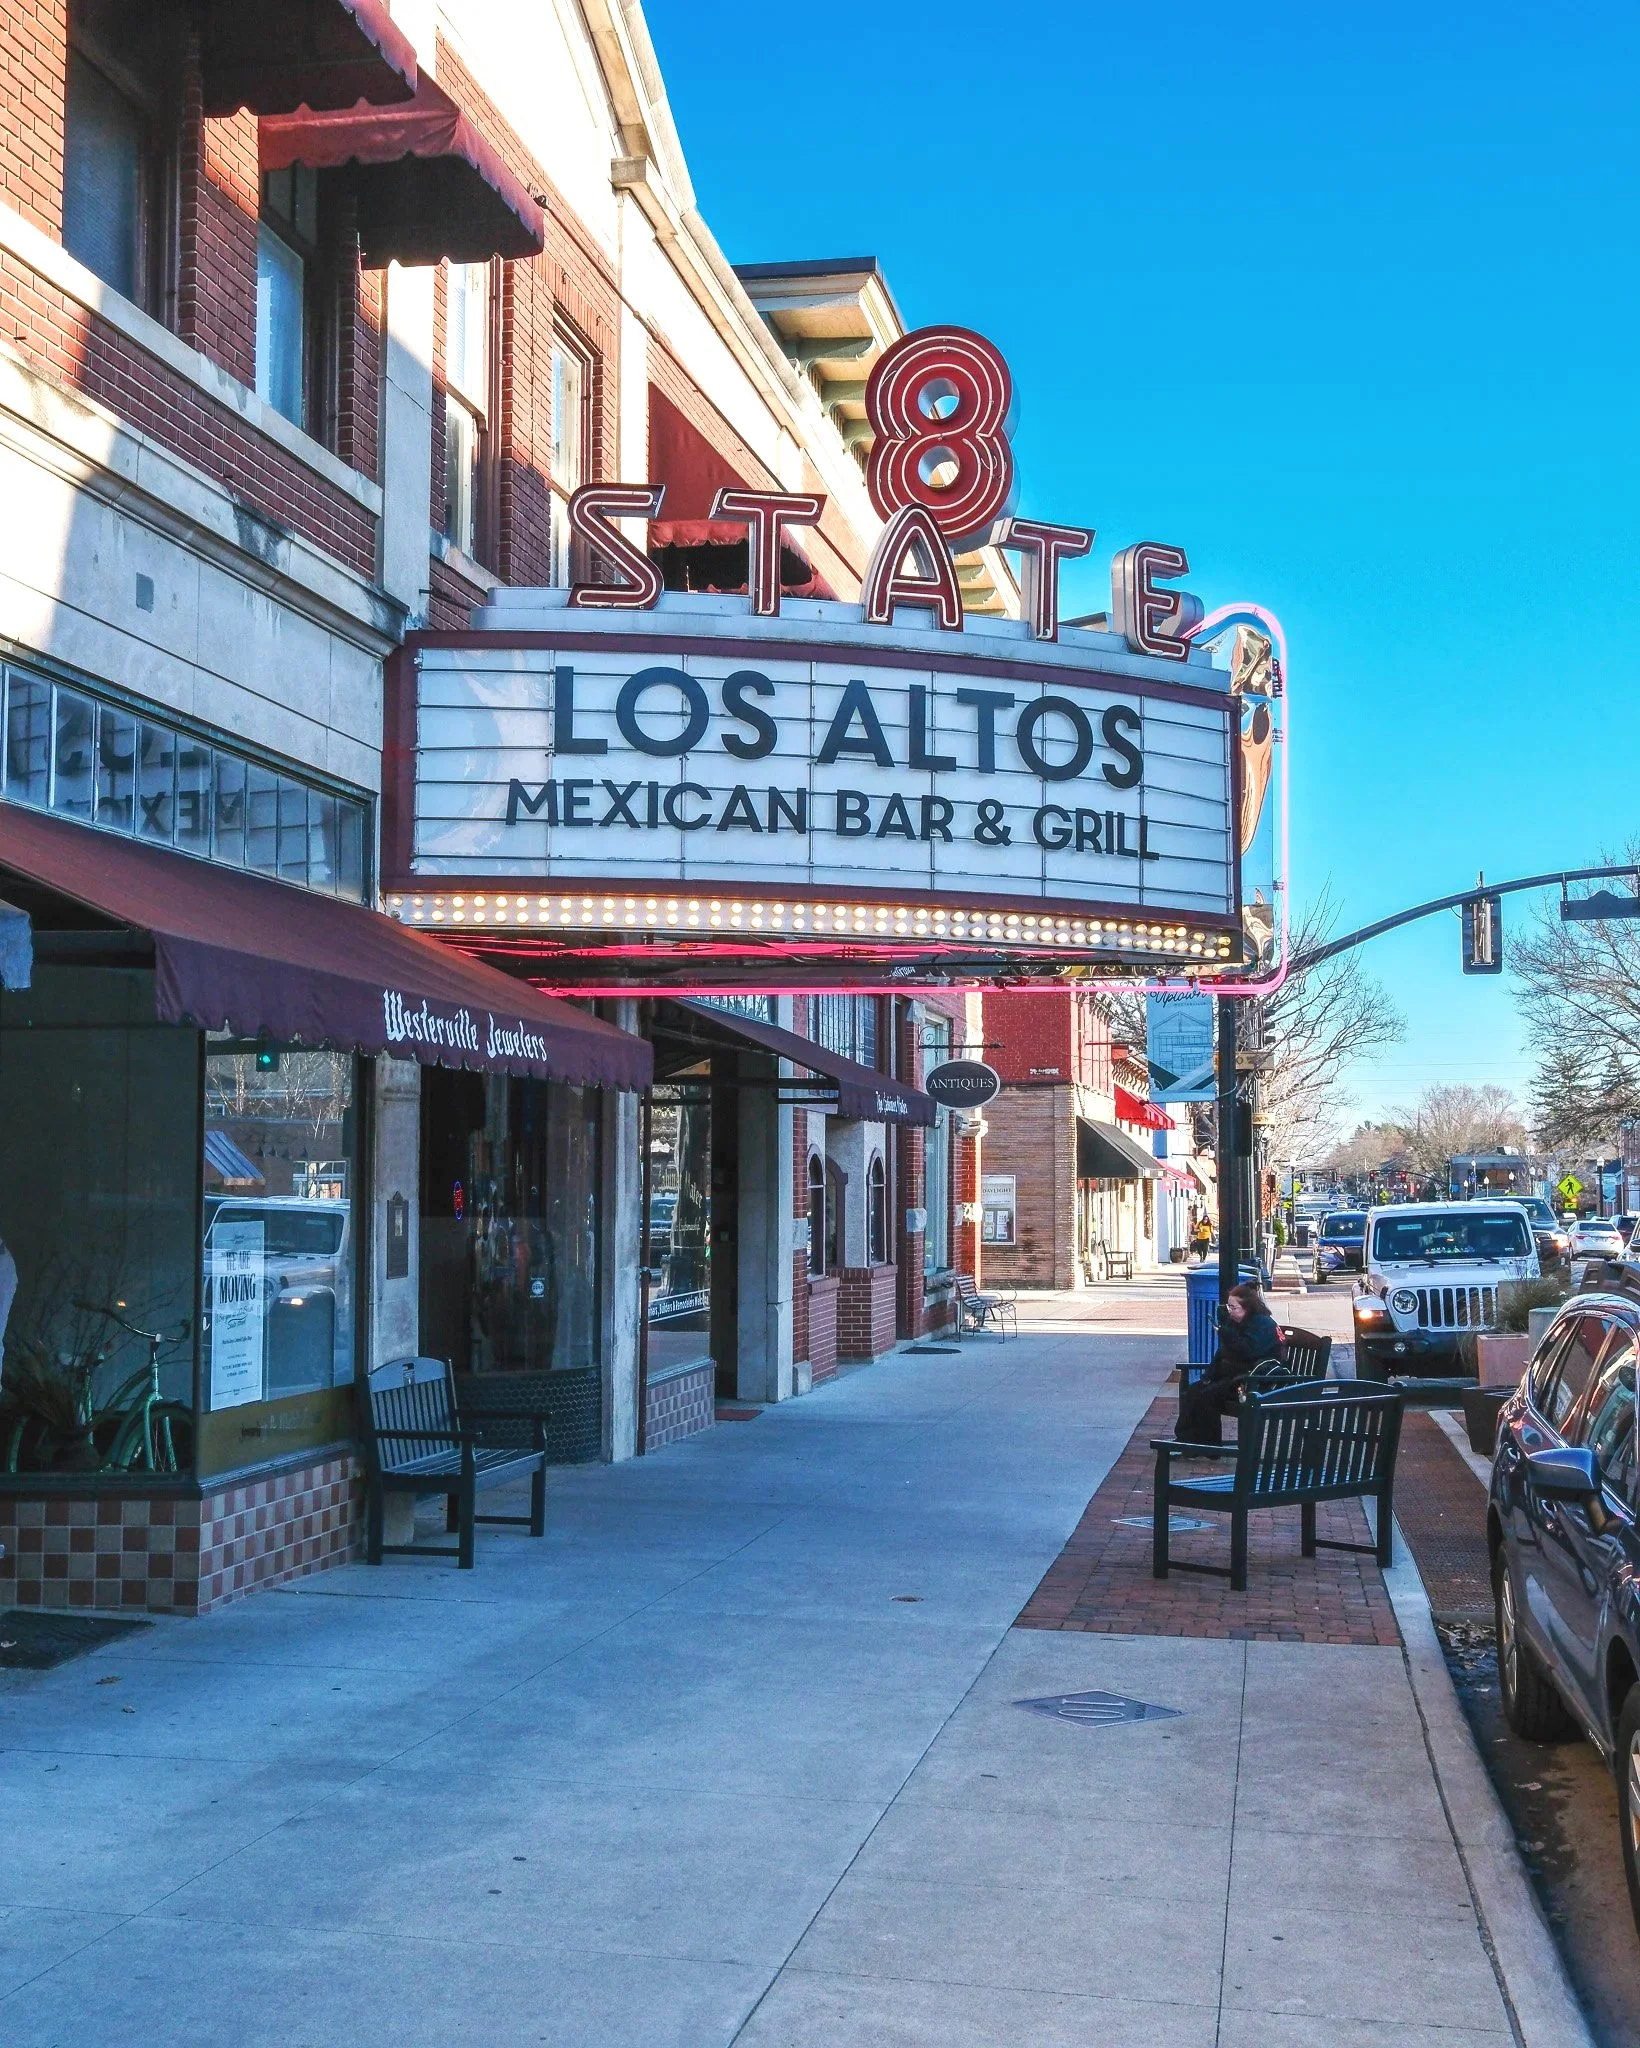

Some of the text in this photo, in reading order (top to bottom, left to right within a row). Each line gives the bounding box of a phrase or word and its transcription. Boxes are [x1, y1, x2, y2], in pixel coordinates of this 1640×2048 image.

[568, 482, 1200, 663] STATE
[555, 666, 1145, 790] LOS ALTOS
[505, 778, 1160, 861] MEXICAN BAR & GRILL
[382, 988, 548, 1063] Westerville Jewelers
[929, 1077, 995, 1091] ANTIQUES
[219, 1272, 256, 1304] MOVING
